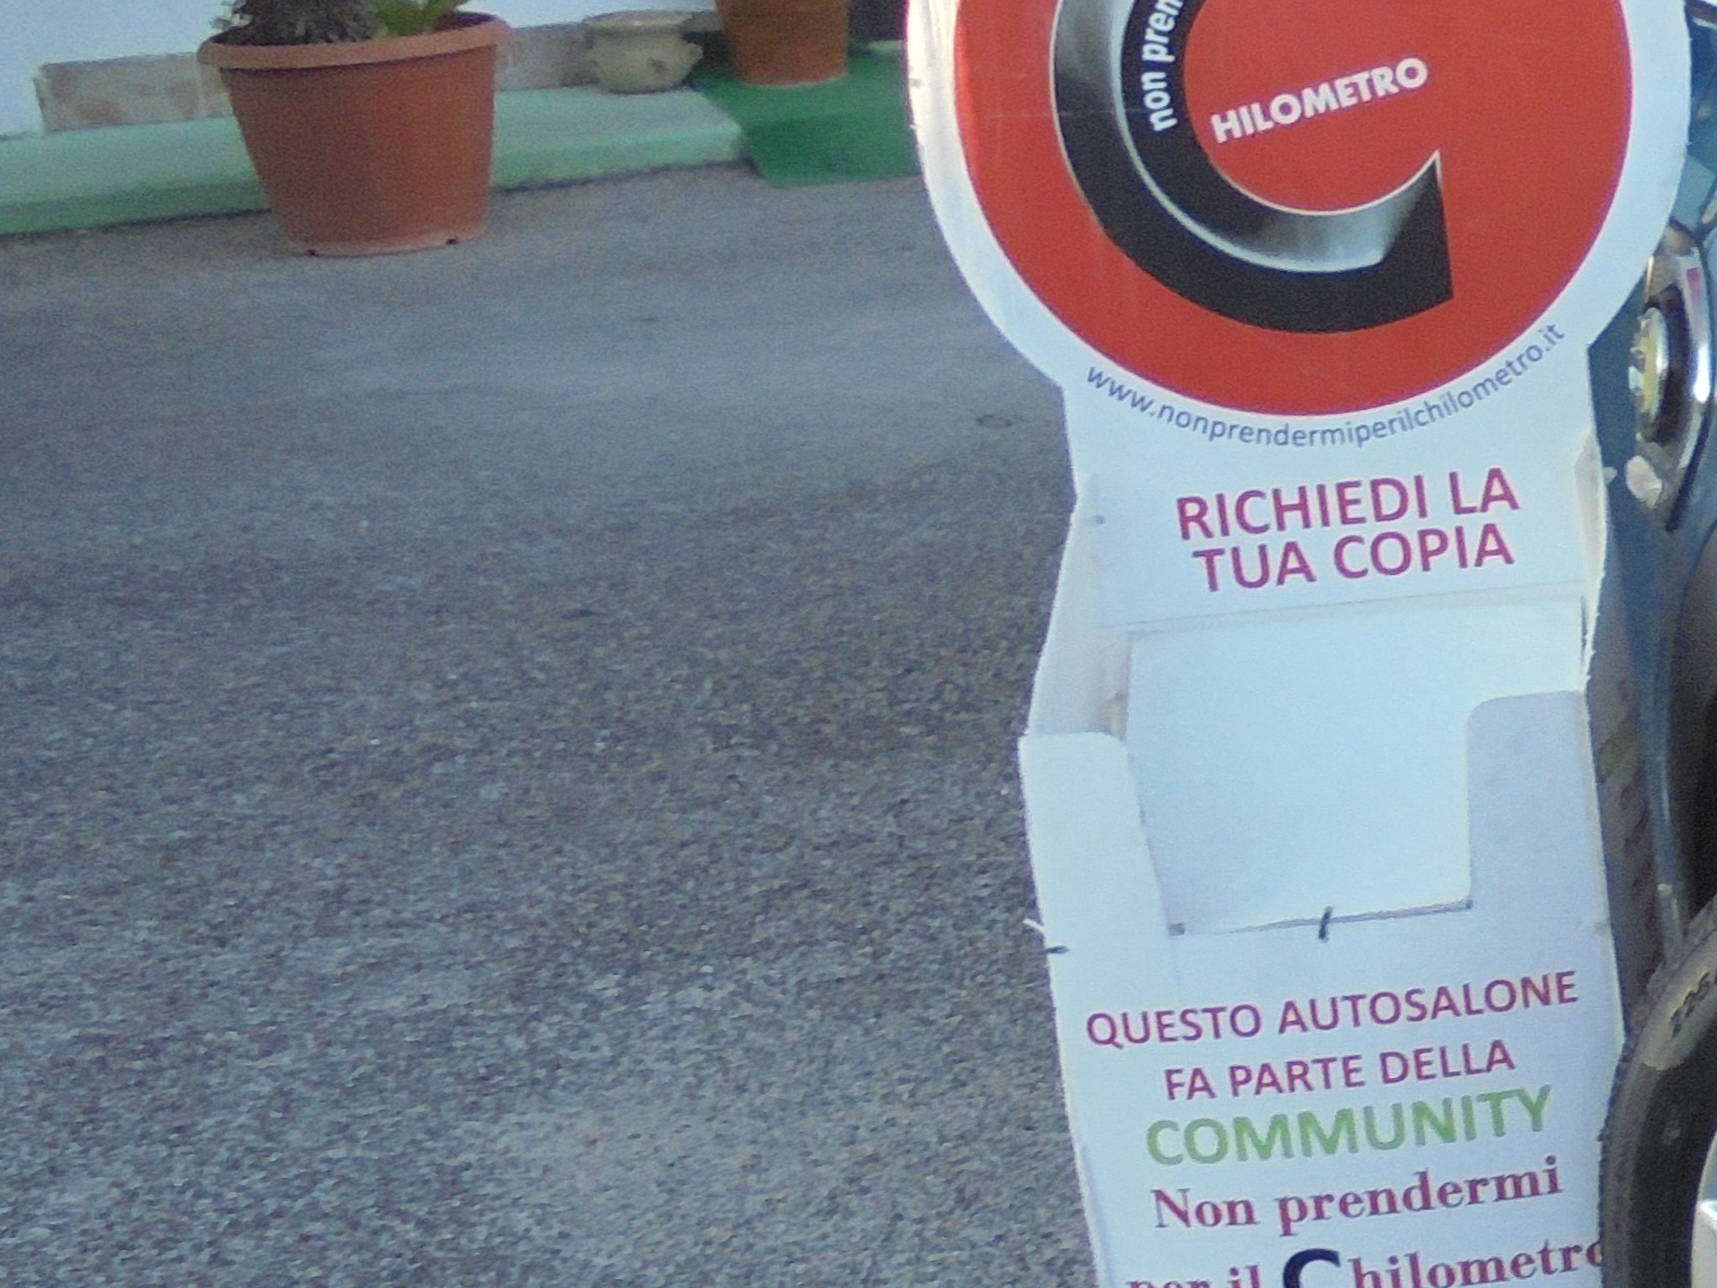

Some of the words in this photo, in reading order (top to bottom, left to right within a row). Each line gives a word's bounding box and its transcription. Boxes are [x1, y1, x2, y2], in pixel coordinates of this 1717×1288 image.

[1141, 71, 1178, 132] non
[1210, 57, 1429, 144] HILOMETRO
[1086, 321, 1566, 448] www.nonprendermiperilchilometro.it
[1176, 473, 1429, 541] RICHIEDI
[1450, 467, 1519, 514] LA
[1192, 541, 1316, 593] TUA
[1333, 523, 1515, 581] COPIA
[1087, 1003, 1261, 1049] QUESTO
[1278, 971, 1579, 1035] AUTOSALONE
[1164, 1067, 1216, 1102] FA
[1230, 1053, 1365, 1098] PARTE
[1381, 1039, 1515, 1085] DELLA
[1146, 1085, 1551, 1166] COMMUNITY
[1151, 1188, 1260, 1229] Non
[1275, 1155, 1563, 1237] prendermi
